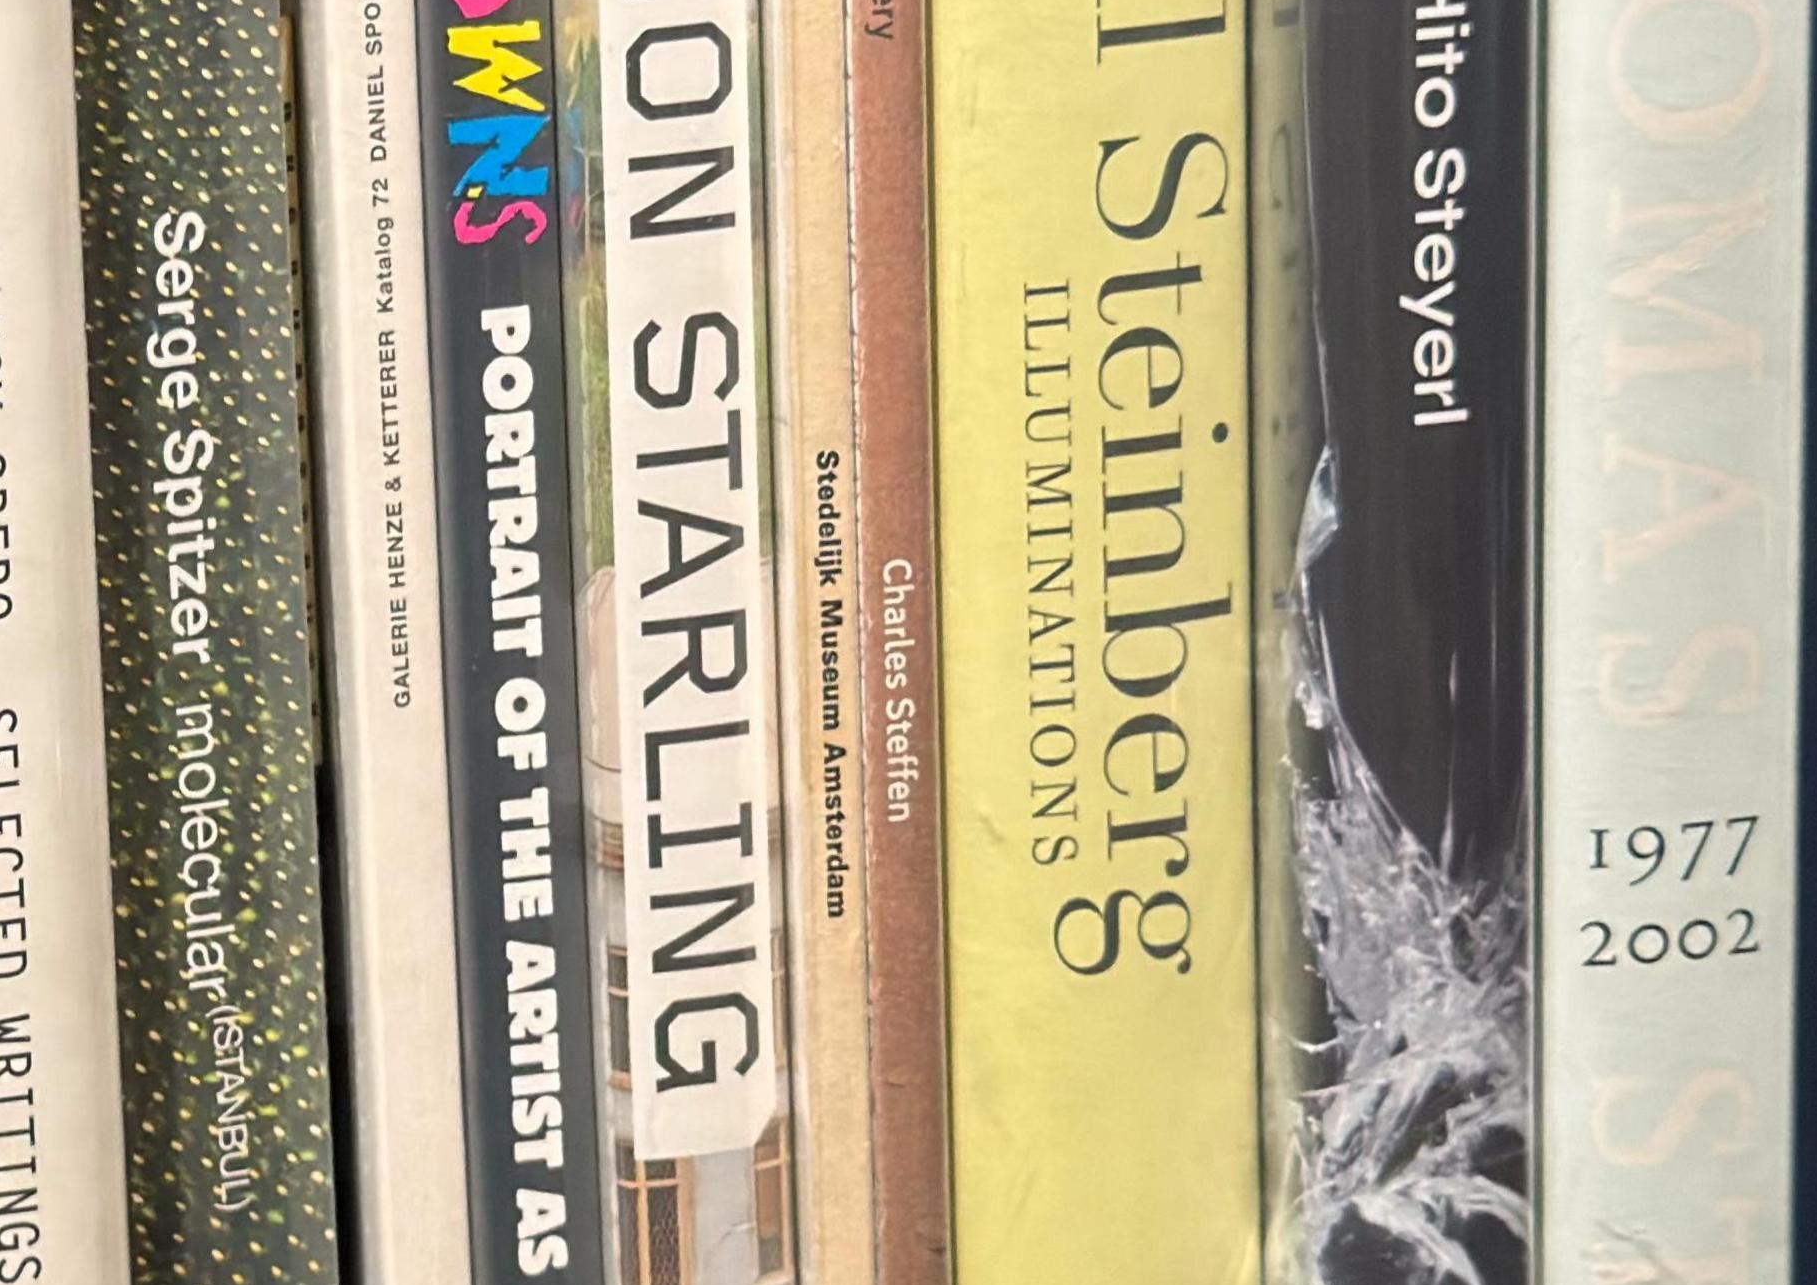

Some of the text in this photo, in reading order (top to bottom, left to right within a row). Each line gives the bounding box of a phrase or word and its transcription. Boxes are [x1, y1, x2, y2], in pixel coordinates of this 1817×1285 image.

[367, 65, 388, 162] DANIEL
[374, 217, 395, 313] Katalog
[1399, 148, 1472, 426] Steyerl
[150, 215, 215, 662] Serge Spitzer
[378, 330, 400, 465] KETTERER
[385, 502, 407, 588] HENZE
[482, 305, 545, 657] PORTRAIT
[1024, 277, 1079, 865] ILLUMINATIONS
[1054, 132, 1232, 975] Steinberg
[390, 599, 411, 708] GALERIE
[635, 313, 760, 1093] STARLING
[814, 450, 849, 918] Stedelijk Museum Amsterdam
[882, 560, 918, 822] Charles Steffen
[497, 677, 549, 767] OF
[505, 790, 554, 920] THE
[1589, 815, 1759, 887] 1977
[1580, 908, 1759, 965] 2002
[509, 940, 567, 1165] ARTIST
[520, 1188, 569, 1272] AS
